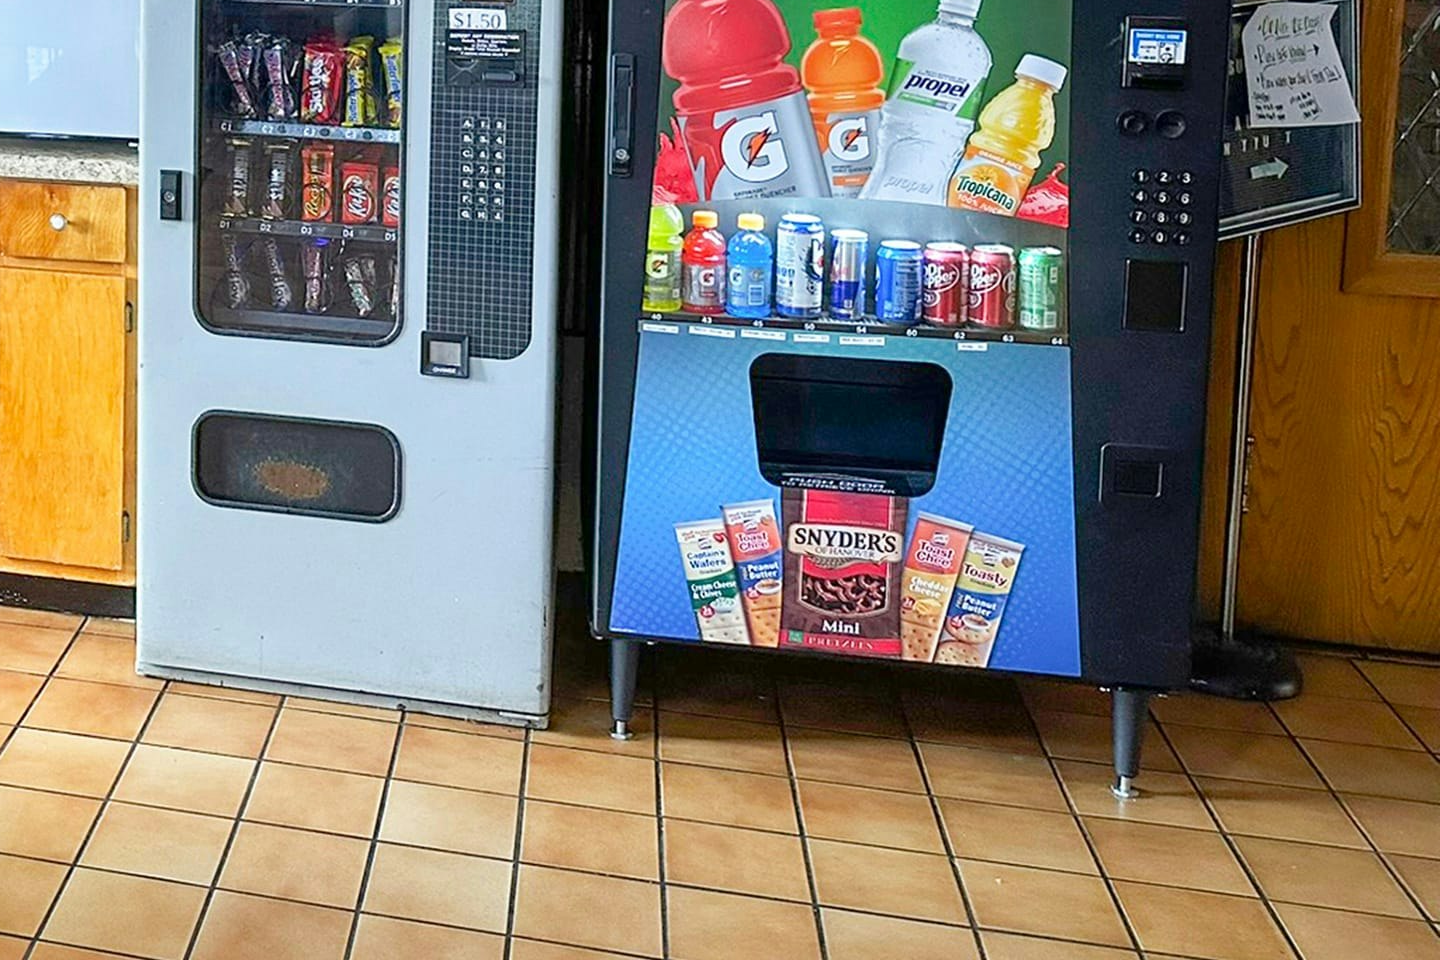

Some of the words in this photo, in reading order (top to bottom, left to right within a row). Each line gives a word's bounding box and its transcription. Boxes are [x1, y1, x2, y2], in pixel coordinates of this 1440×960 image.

[453, 12, 501, 29] $1.50
[903, 74, 970, 97] propel
[720, 110, 789, 183] G
[828, 117, 871, 162] G
[1138, 171, 1144, 181] 1
[1160, 172, 1168, 182] 2
[1182, 173, 1190, 183] 3
[957, 175, 1015, 210] Tropicana
[1136, 191, 1144, 201] 4
[1159, 192, 1166, 202] 5
[1181, 193, 1189, 204] 6
[1135, 211, 1143, 222] 7
[1157, 212, 1165, 222] 8
[1179, 213, 1188, 224] 9
[1155, 232, 1163, 242] 0
[645, 253, 668, 279] G
[700, 269, 715, 286] G
[794, 527, 897, 554] SNYDER'S
[686, 550, 725, 560] Captain's
[828, 547, 876, 558] HANOVER
[689, 559, 727, 569] Wafers
[747, 562, 779, 572] Peanut
[749, 570, 778, 579] Butter
[964, 563, 1008, 586] Toasty
[962, 601, 993, 617] Butter
[964, 594, 997, 610] Peanut
[822, 620, 861, 635] Mini
[808, 637, 873, 649] PRETZELS
